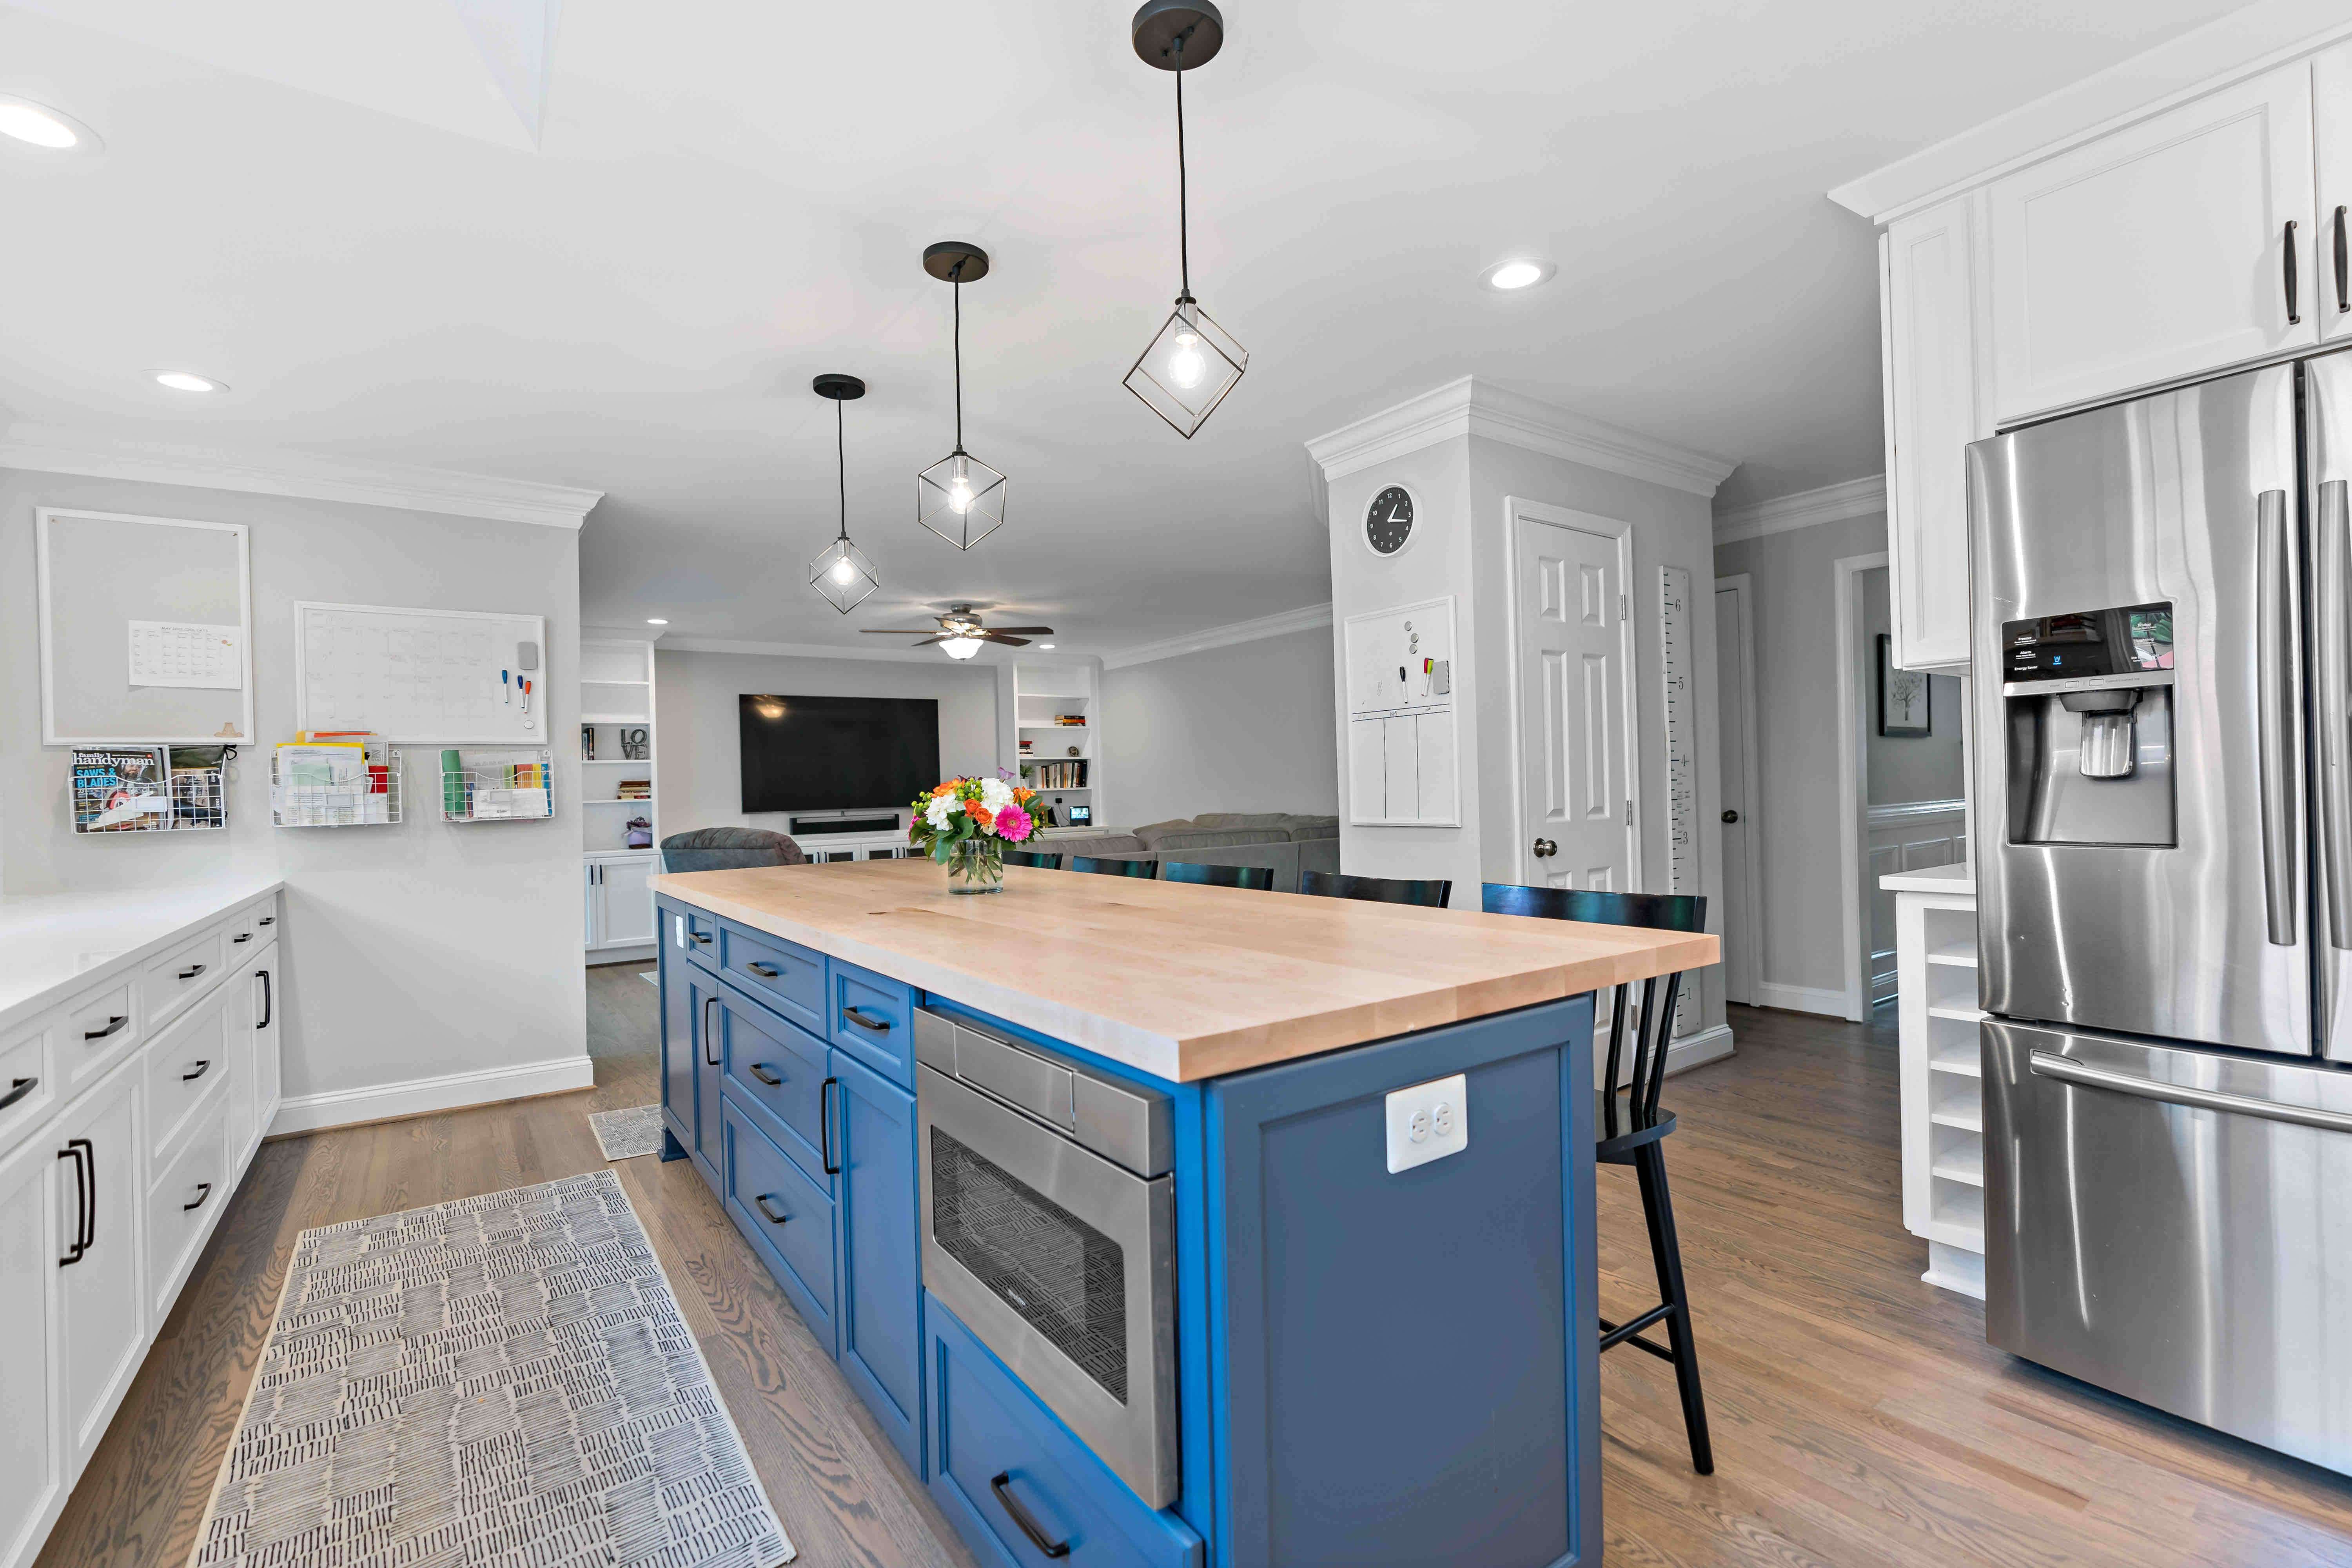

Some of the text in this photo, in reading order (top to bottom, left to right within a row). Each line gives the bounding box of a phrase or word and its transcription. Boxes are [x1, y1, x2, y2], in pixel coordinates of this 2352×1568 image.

[1675, 598, 1681, 612] 6
[1678, 677, 1684, 690] 5
[72, 752, 155, 766] handyman
[1681, 754, 1690, 767] 4
[77, 768, 116, 777] SAWS &
[77, 777, 117, 788] BLADES
[1682, 831, 1689, 845] 3
